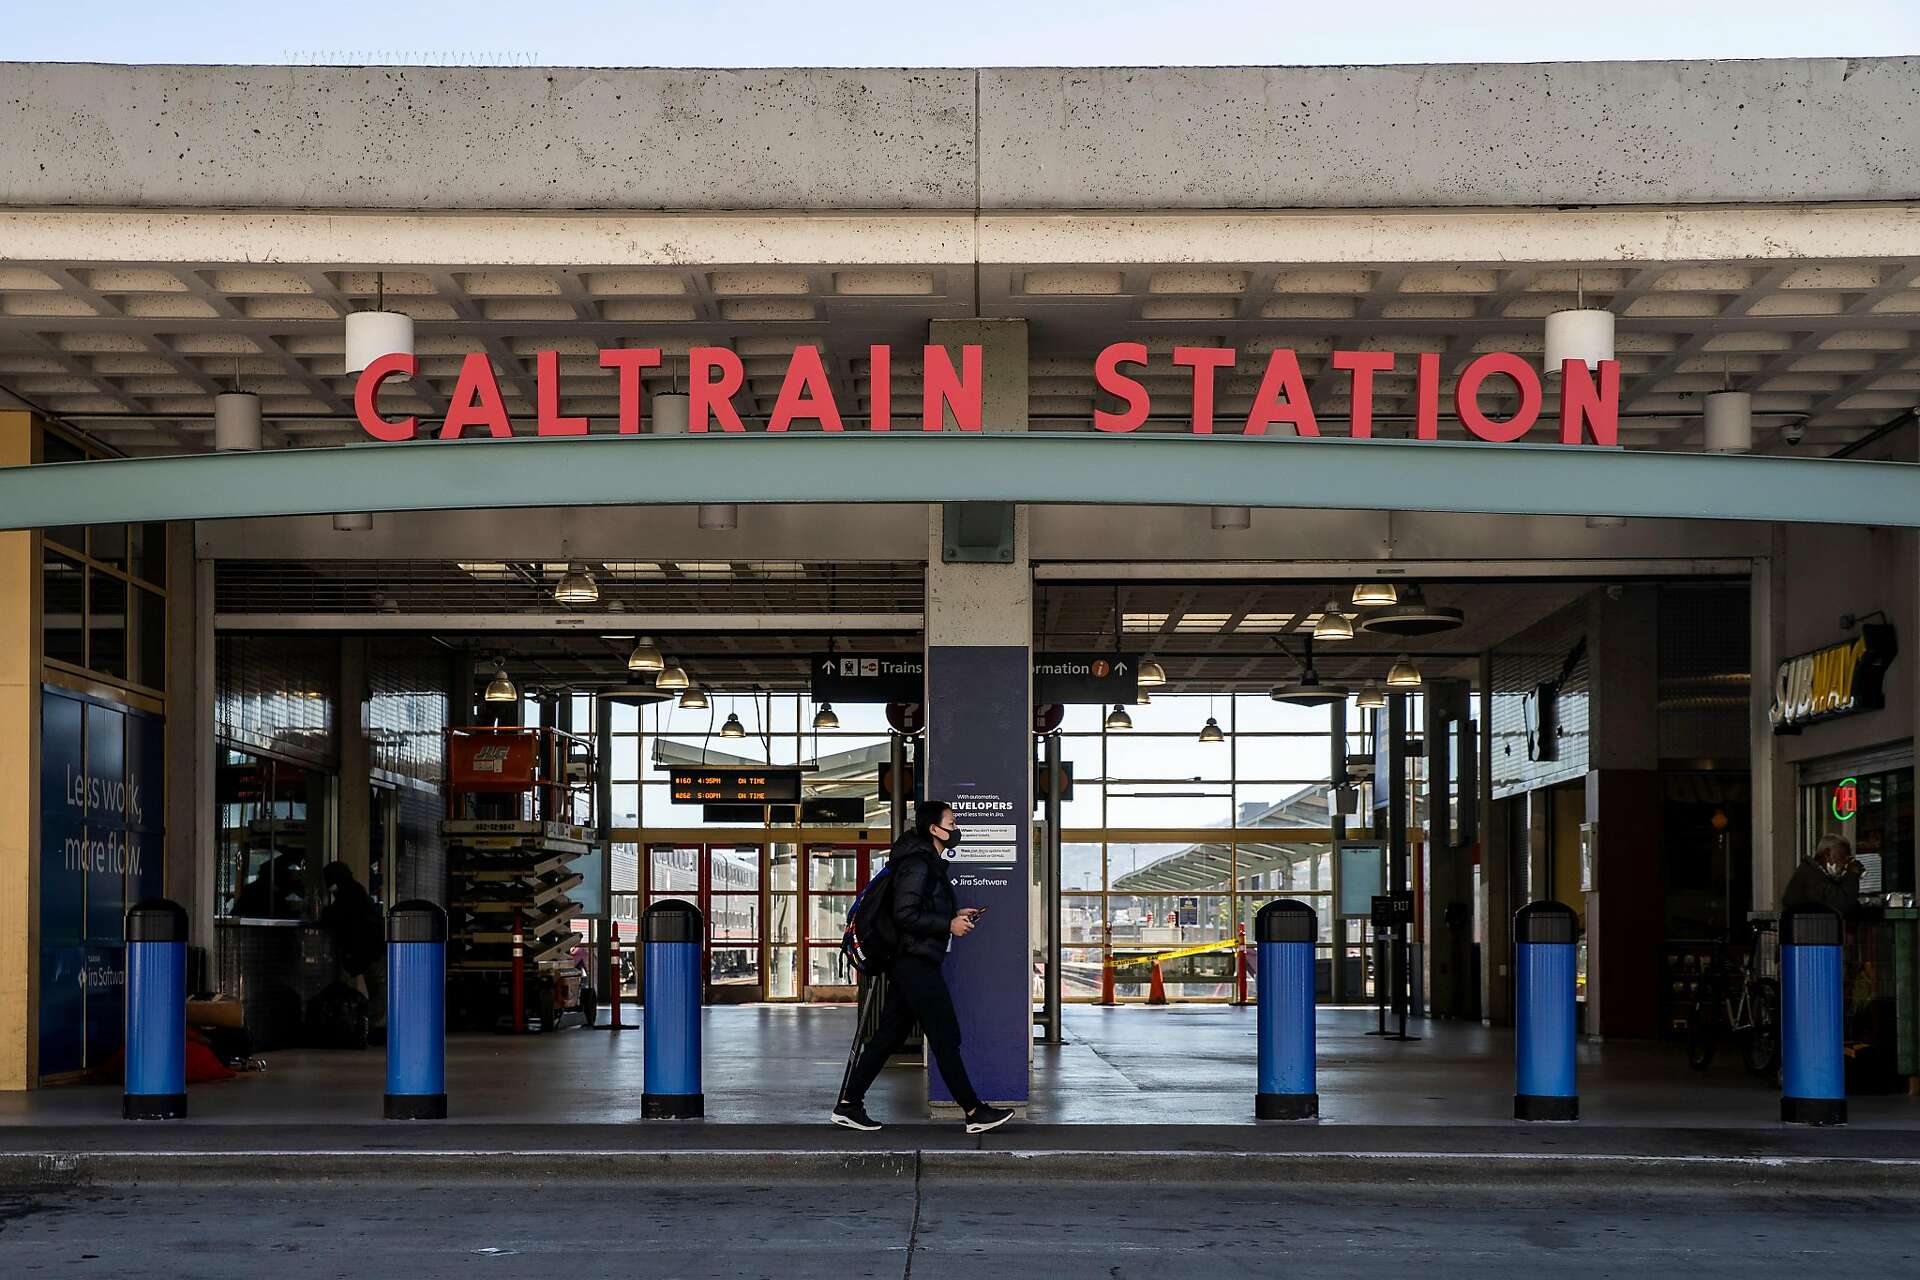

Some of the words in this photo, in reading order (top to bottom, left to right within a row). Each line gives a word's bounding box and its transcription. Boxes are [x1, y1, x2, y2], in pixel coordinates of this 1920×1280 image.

[354, 343, 984, 442] CALTRAIN
[1093, 341, 1622, 446] STATION
[881, 661, 923, 675] Trains
[1032, 661, 1089, 675] rmation
[1768, 637, 1867, 727] SUBWAY
[66, 762, 100, 809] Less
[737, 777, 747, 785] ON
[749, 777, 765, 785] TIME
[64, 837, 106, 873] more
[108, 831, 143, 876] flow.
[959, 878, 972, 886] Jira
[973, 878, 1008, 886] Software
[1393, 901, 1409, 911] EXIT
[98, 965, 124, 986] Softwa
